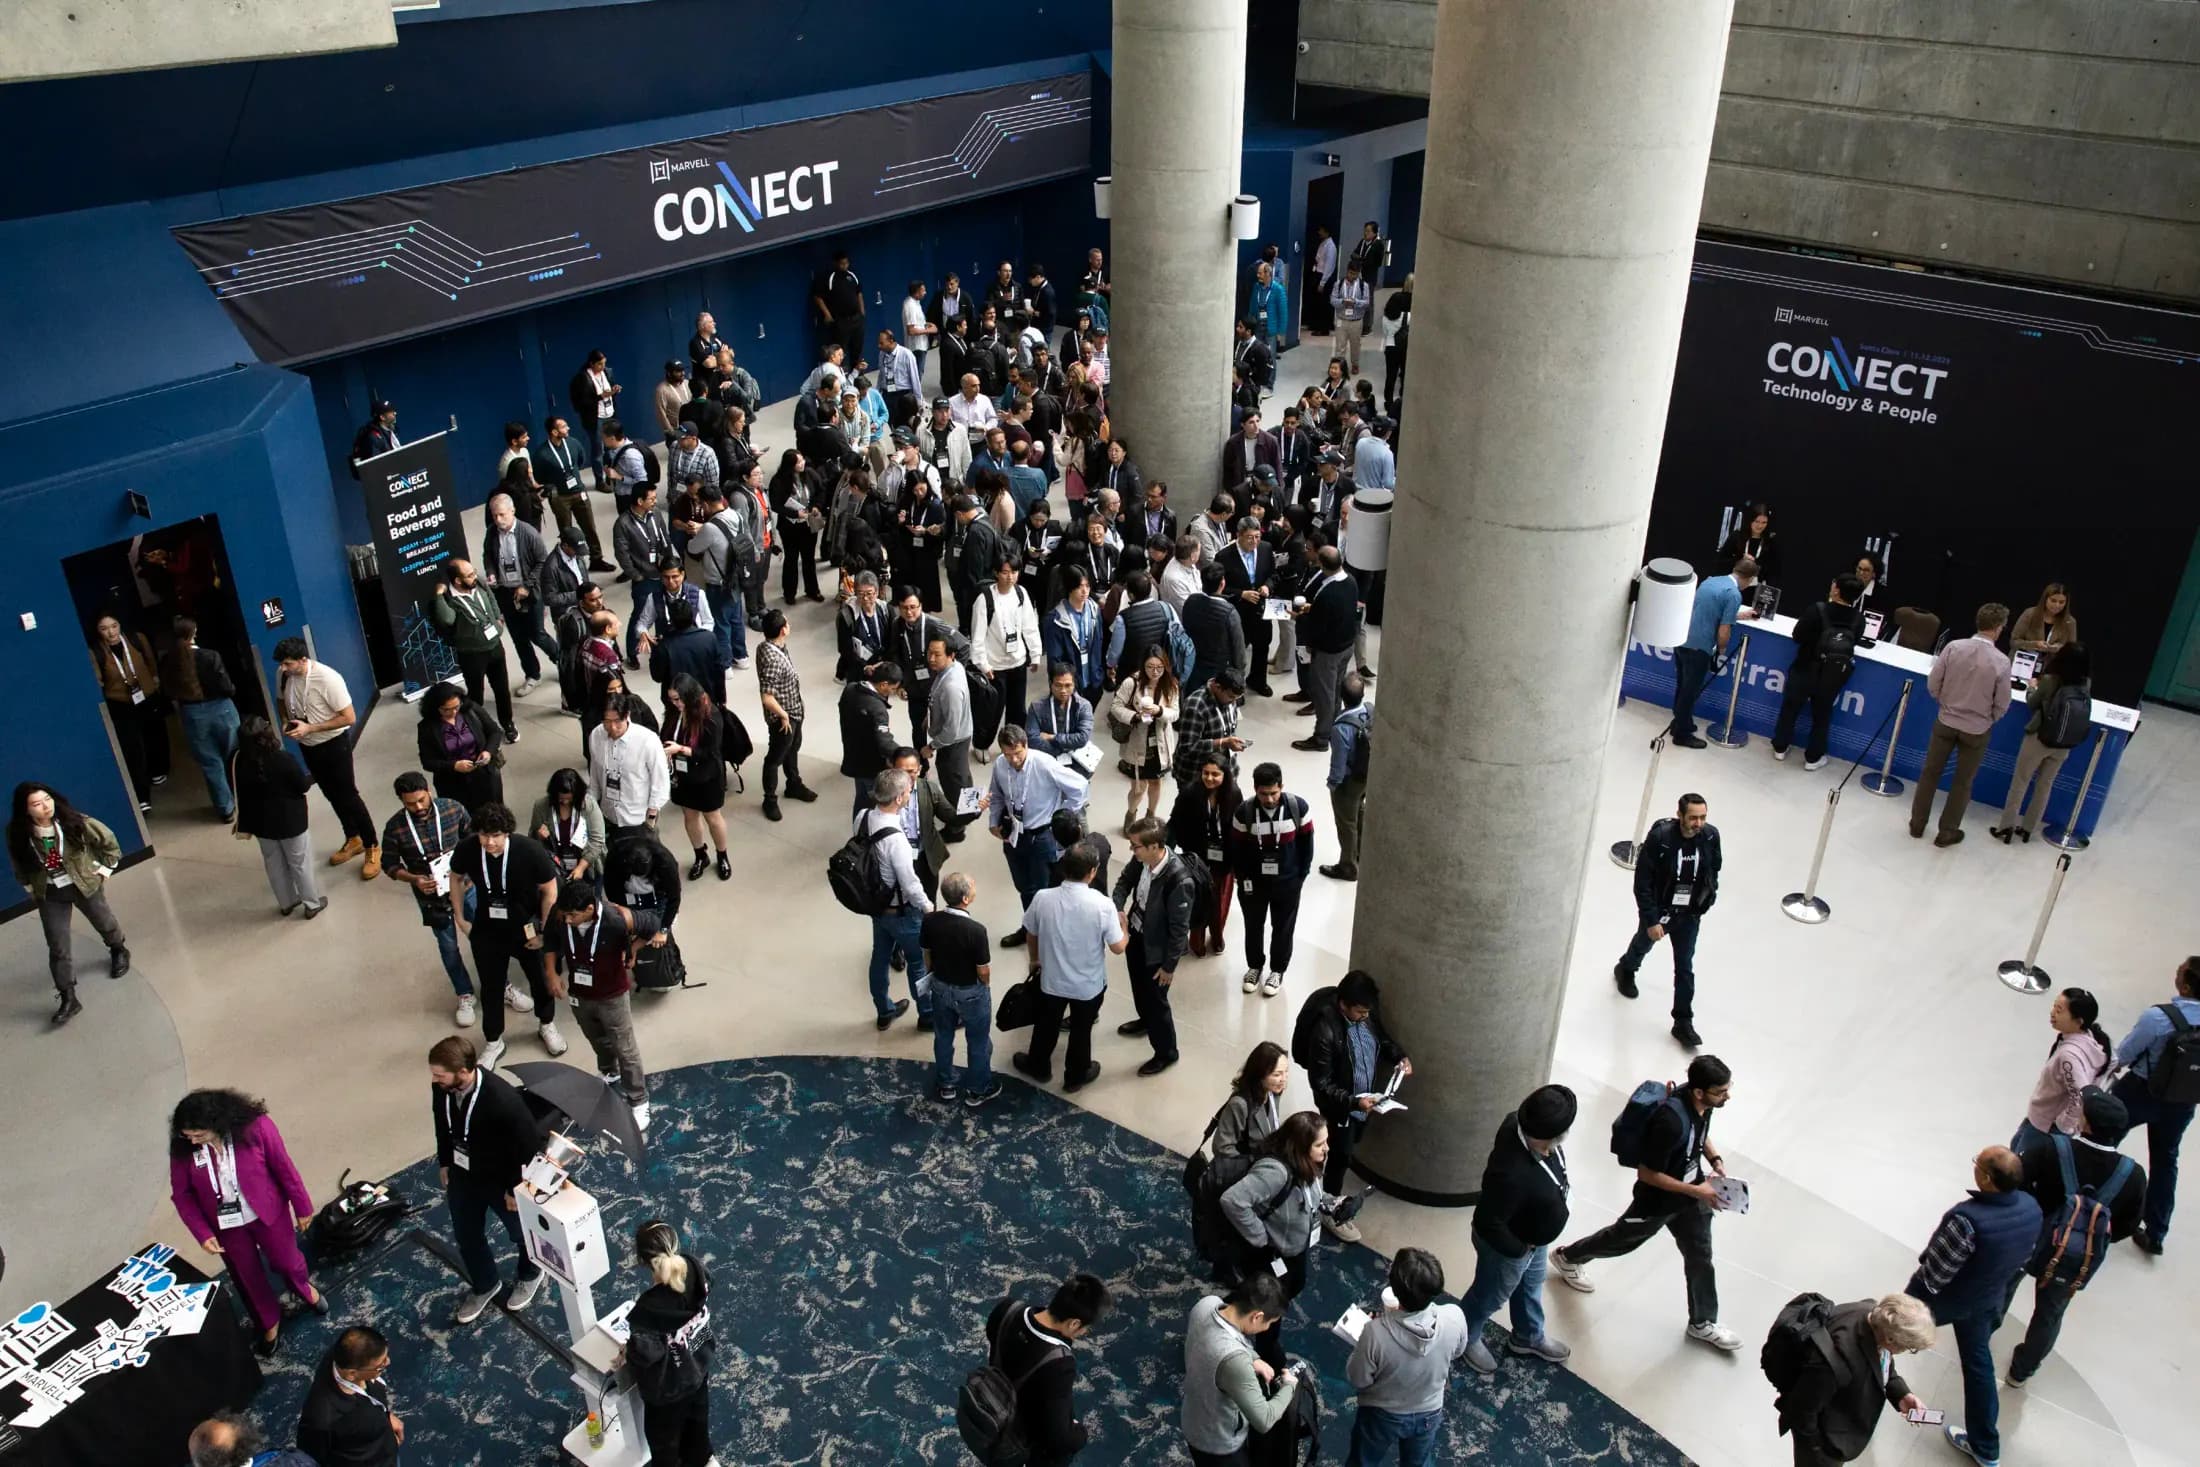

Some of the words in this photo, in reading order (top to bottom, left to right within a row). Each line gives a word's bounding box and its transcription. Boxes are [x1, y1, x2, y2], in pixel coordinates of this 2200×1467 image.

[671, 158, 711, 173] MARVELL
[653, 160, 839, 242] CONNECT
[1793, 313, 1830, 327] MARVELL
[1767, 336, 1949, 400] CONNECT
[1762, 378, 1859, 412] Technology
[1860, 397, 1875, 413] &
[1877, 400, 1938, 425] People
[387, 504, 418, 527] Food
[420, 495, 443, 514] and
[389, 512, 446, 540] Beverage
[406, 541, 440, 559] BREAKFAST
[416, 563, 438, 576] LUNCH
[144, 1244, 175, 1263] IN
[122, 1257, 164, 1281] ALL
[145, 1295, 201, 1328] MARVELL
[21, 1371, 64, 1401] MARVELL
